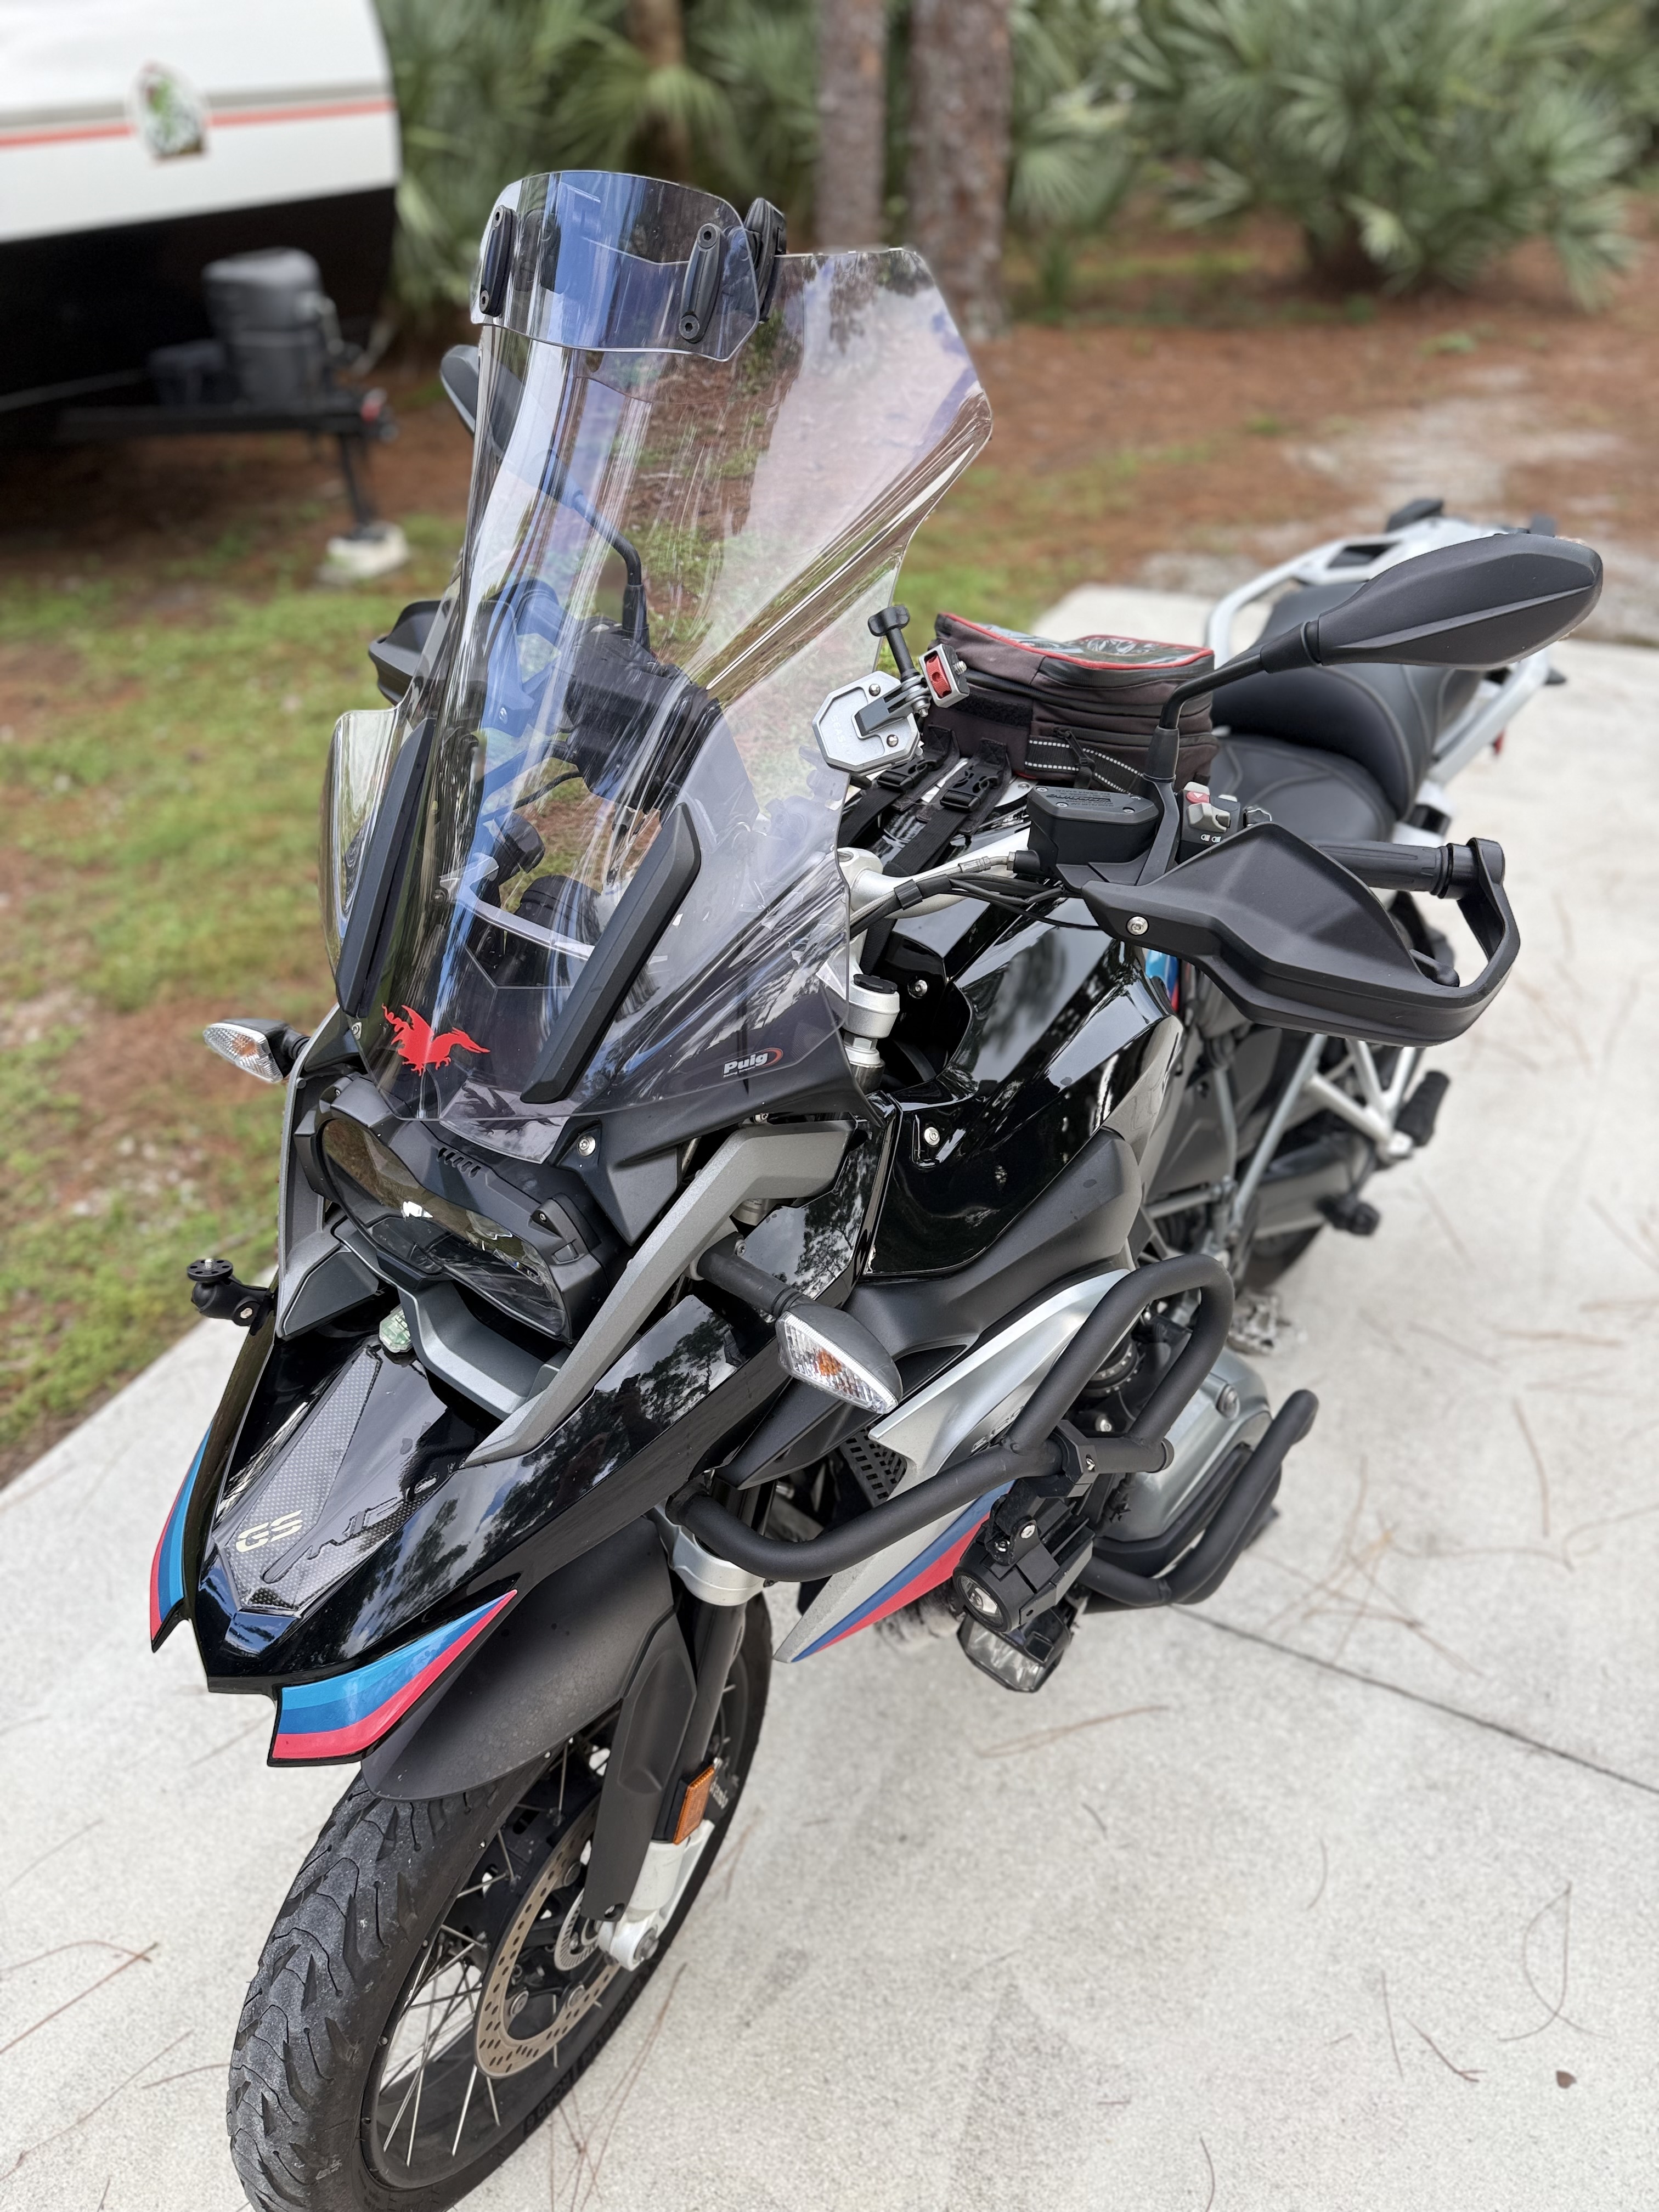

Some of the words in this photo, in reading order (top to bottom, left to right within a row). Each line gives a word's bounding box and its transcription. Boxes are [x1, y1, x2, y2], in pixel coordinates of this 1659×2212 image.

[723, 1053, 768, 1074] Puig
[235, 1509, 303, 1553] GS
[537, 2073, 572, 2119] ROAD
